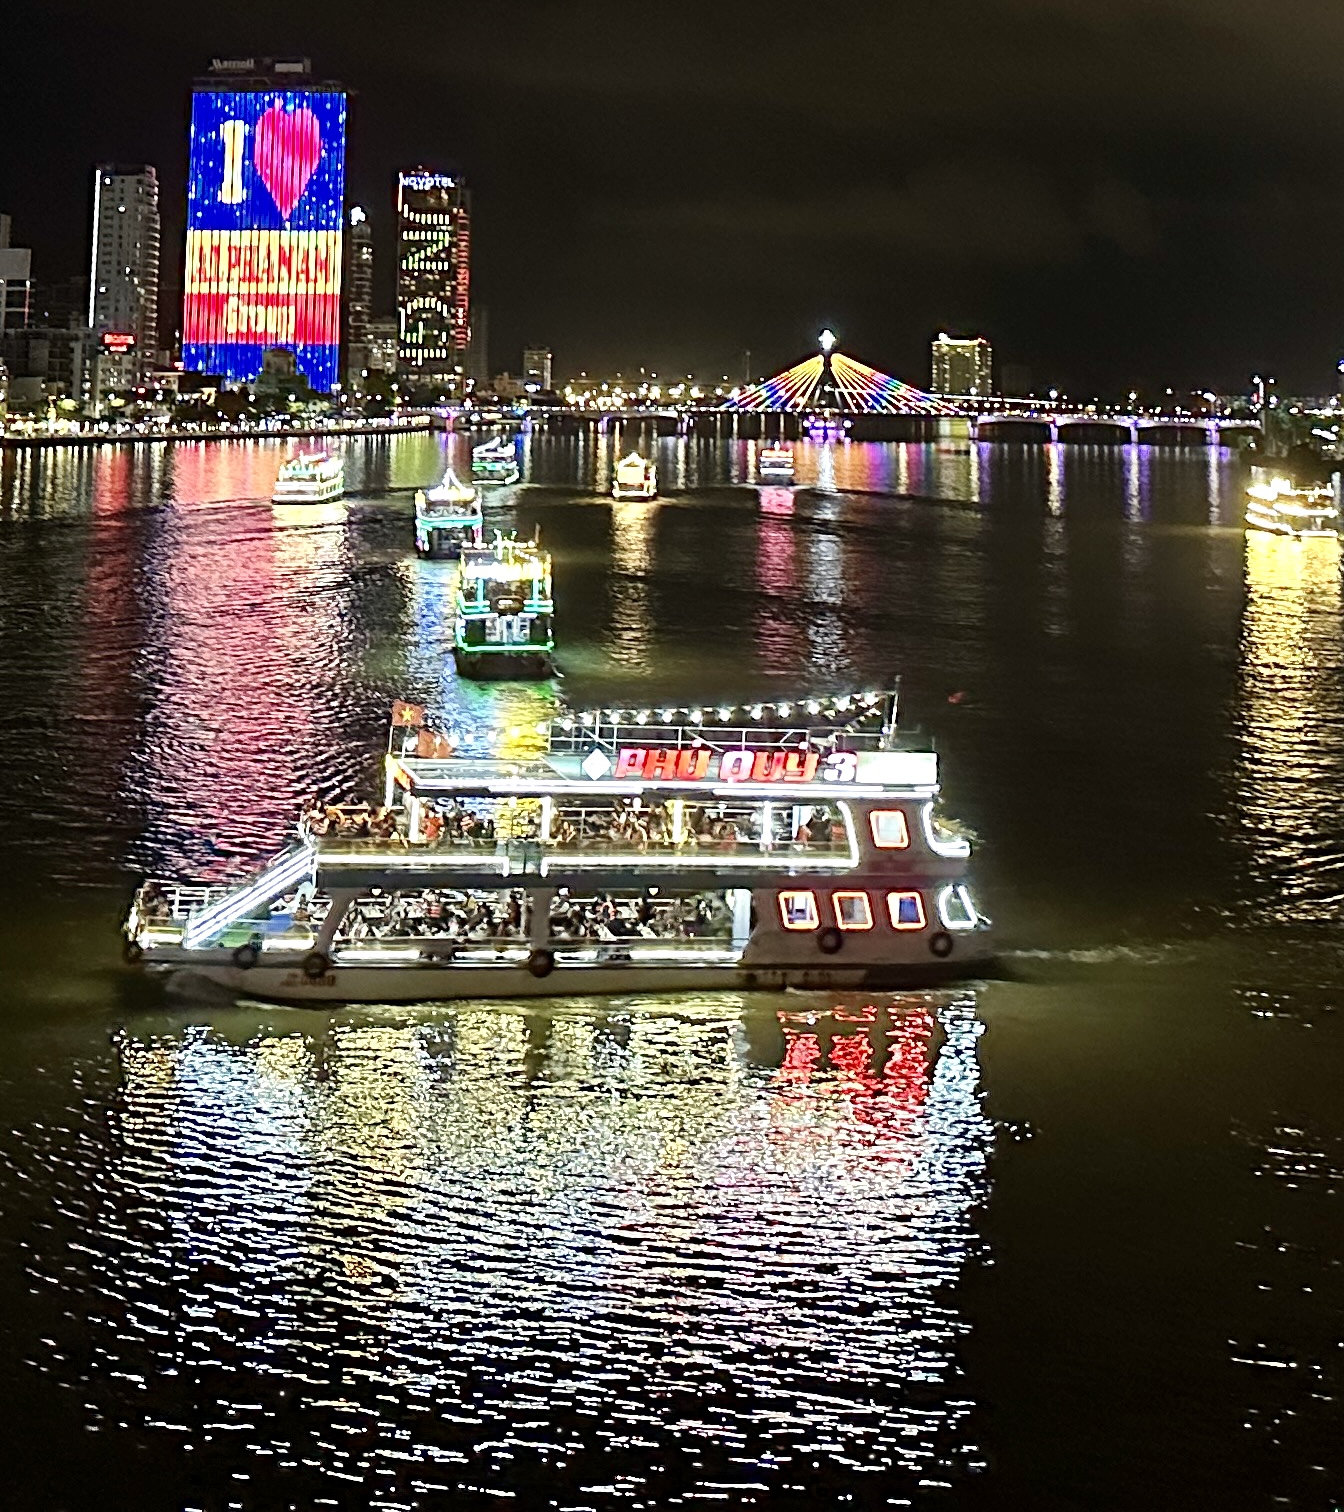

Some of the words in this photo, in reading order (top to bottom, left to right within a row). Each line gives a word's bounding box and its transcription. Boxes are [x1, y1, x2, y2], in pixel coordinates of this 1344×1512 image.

[218, 119, 250, 204] I
[400, 175, 455, 188] NOVOTEL
[193, 245, 332, 283] ALPHANAM
[824, 752, 857, 782] 3
